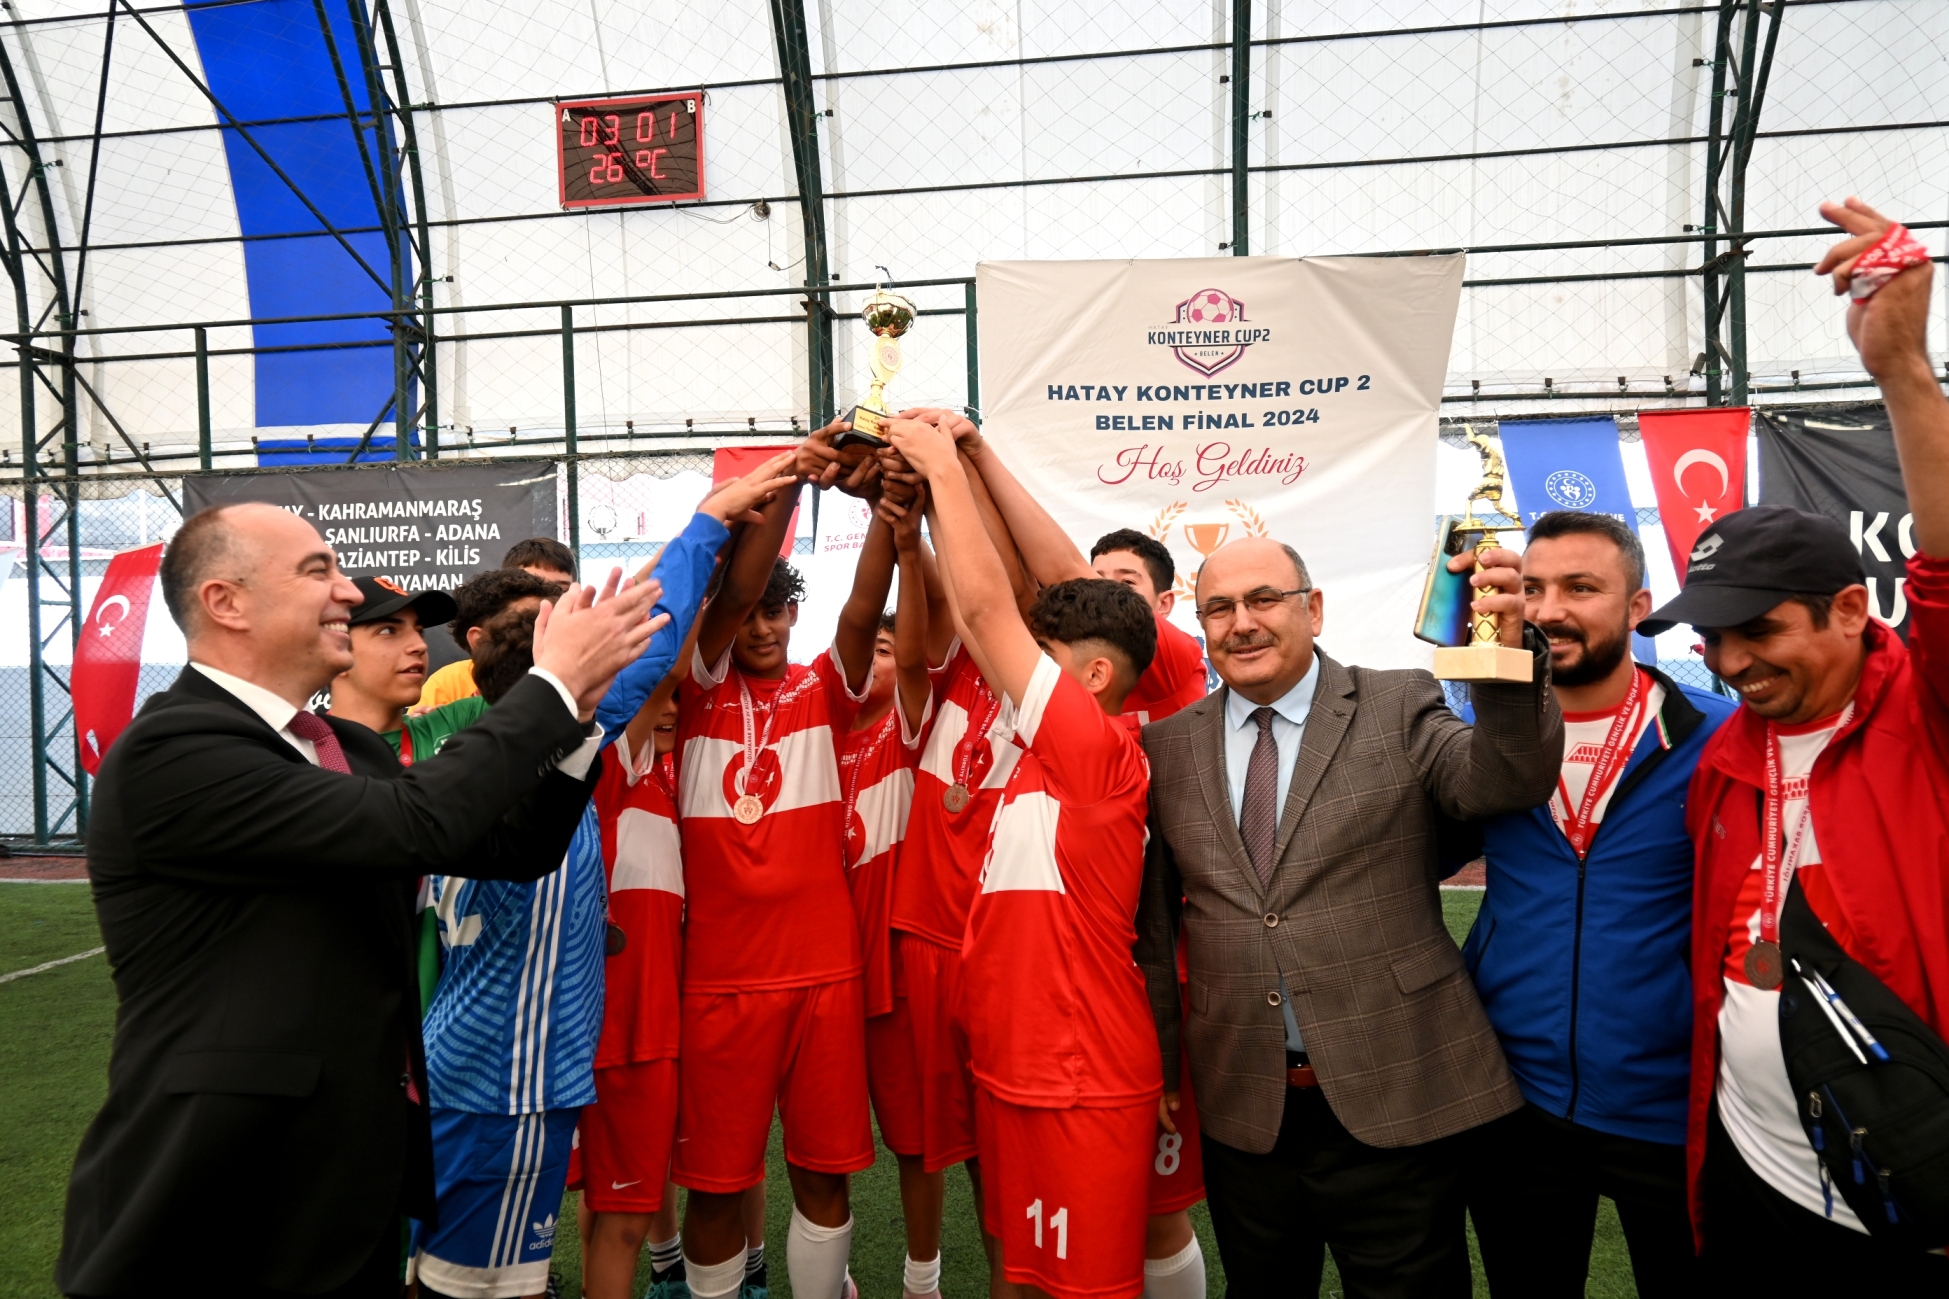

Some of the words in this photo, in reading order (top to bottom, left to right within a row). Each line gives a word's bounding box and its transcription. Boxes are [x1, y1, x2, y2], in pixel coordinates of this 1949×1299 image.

[562, 109, 571, 122] A
[687, 99, 696, 113] B
[580, 115, 620, 147] 03
[636, 112, 677, 143] 01
[589, 152, 624, 184] 26
[1148, 329, 1230, 345] KONTEYNER
[1235, 328, 1271, 343] CUP2
[1047, 384, 1129, 402] HATAY
[1136, 381, 1291, 402] KONTEYNER
[1299, 376, 1350, 396] CUP
[1356, 374, 1371, 391] 2
[1095, 414, 1174, 431] BELEN
[1182, 410, 1255, 431] FİNAL
[1262, 407, 1320, 427] 2024
[1097, 443, 1188, 487] Hoş
[1192, 441, 1310, 493] Geldiniz
[318, 498, 483, 521] KAHRAMANMARAŞ
[324, 525, 421, 548] ŞANLIURFA
[435, 523, 501, 542] ADANA
[824, 542, 850, 552] SPOR
[337, 548, 421, 569] AZİANTEP
[436, 544, 480, 566] KİLİS
[1577, 798, 1593, 829] TÜRKİYE
[1588, 746, 1613, 797] CUMHURİYETİ
[1609, 717, 1627, 748] GENÇLİK
[1621, 706, 1631, 716] VE
[1627, 689, 1638, 707] SPOR
[1766, 747, 1774, 758] VE
[1766, 759, 1779, 796] GENÇLİK
[1766, 798, 1779, 862] CUMHURİYETİ
[1764, 863, 1776, 904] TÜRKİYE
[1154, 1132, 1183, 1176] 8
[1026, 1198, 1068, 1260] 11
